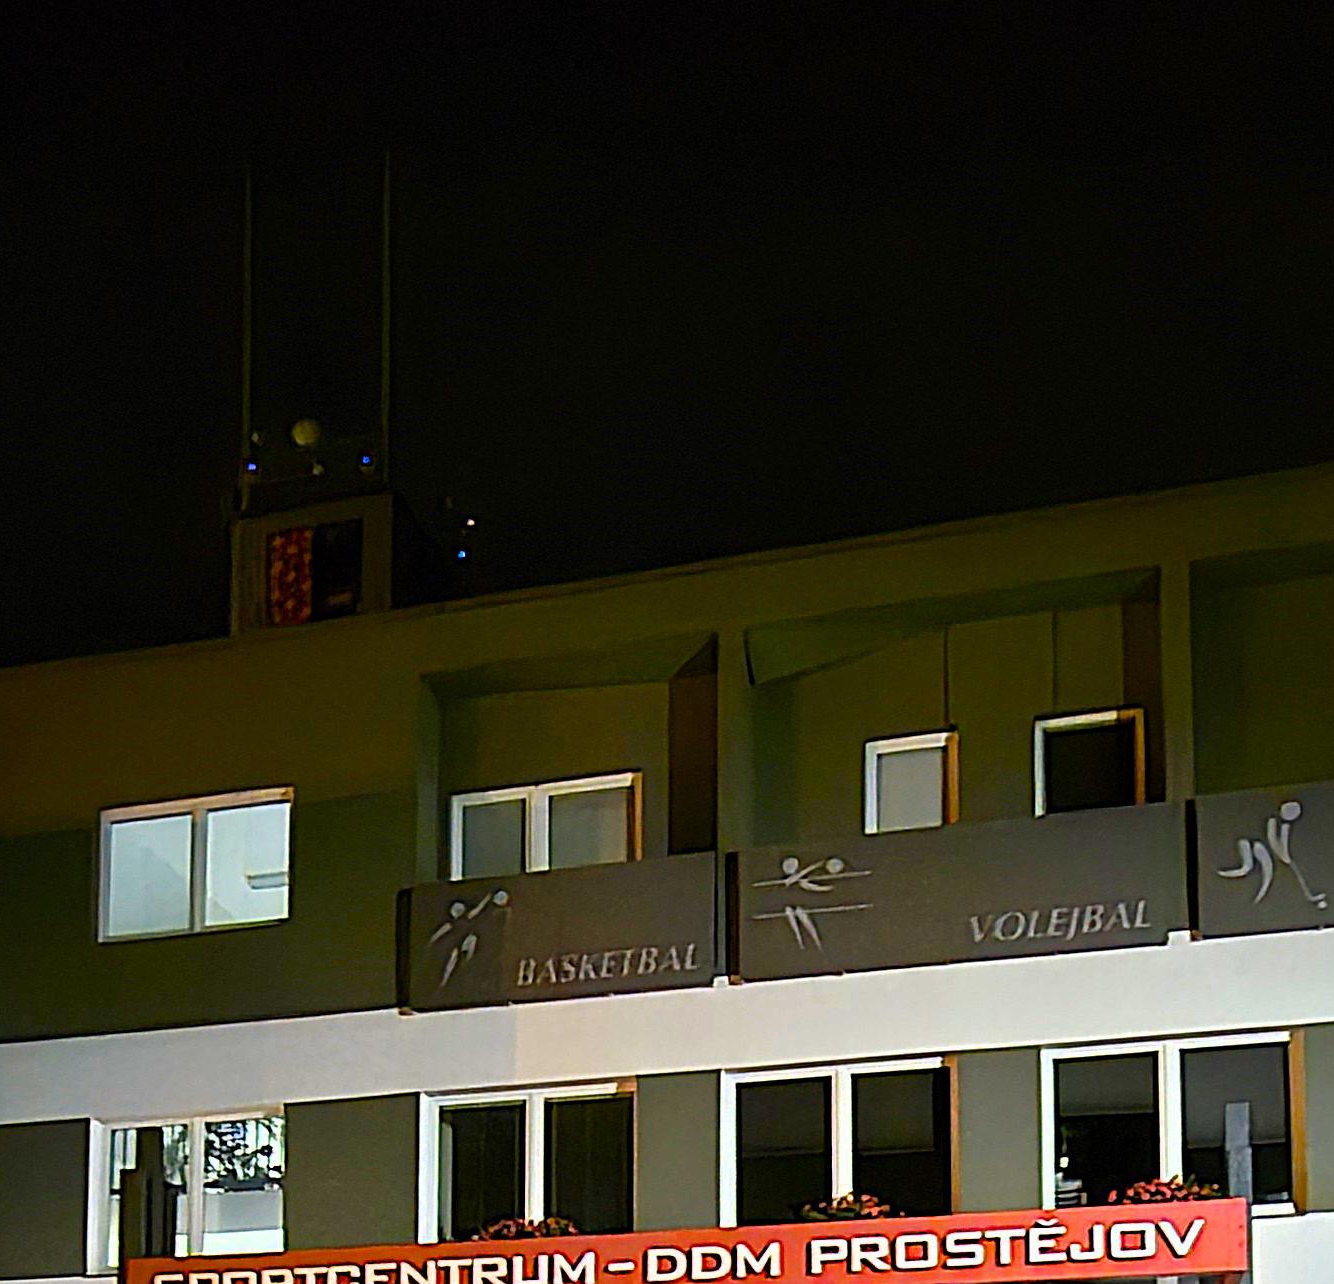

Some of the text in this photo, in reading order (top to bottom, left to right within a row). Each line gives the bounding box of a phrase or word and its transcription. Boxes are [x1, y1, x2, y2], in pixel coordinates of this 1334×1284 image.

[969, 899, 1152, 945] VOLEJBAL
[515, 943, 699, 988] BASKETBAL
[646, 1241, 782, 1283] DDM
[809, 1218, 1205, 1275] PROSTĚJOV
